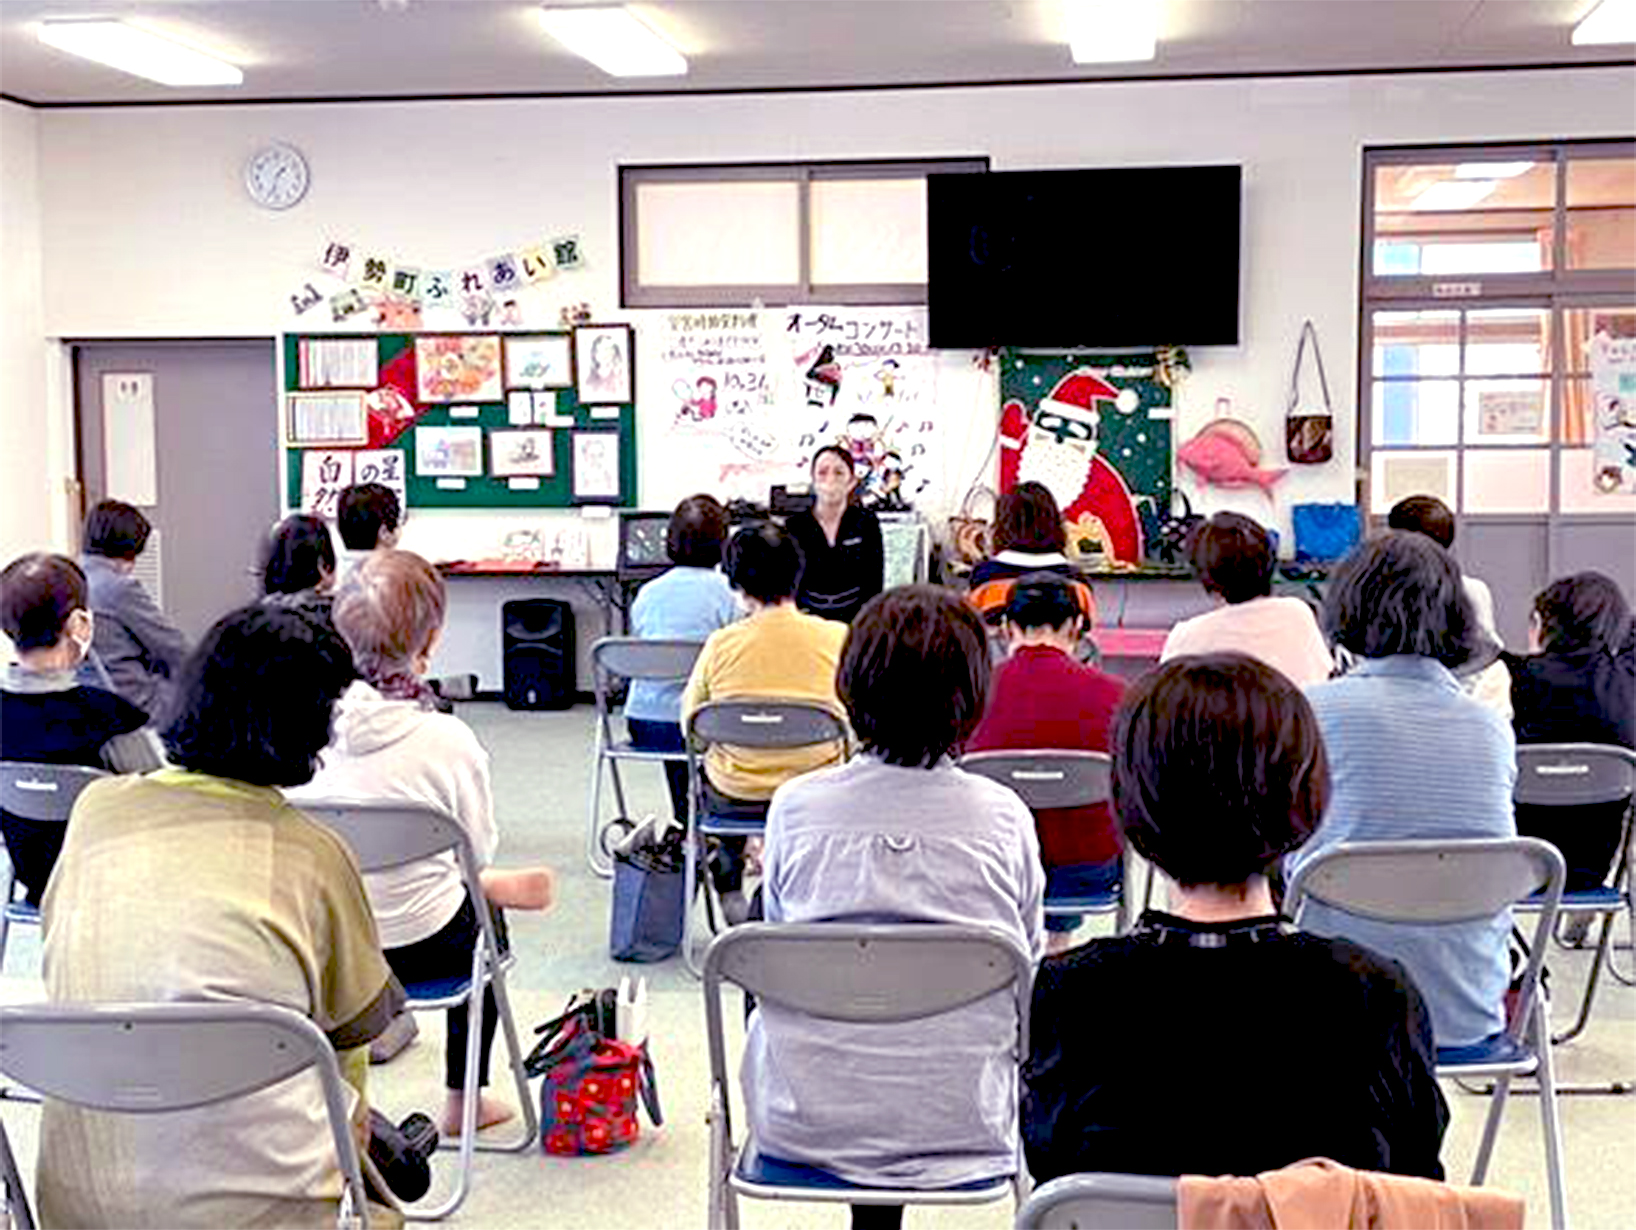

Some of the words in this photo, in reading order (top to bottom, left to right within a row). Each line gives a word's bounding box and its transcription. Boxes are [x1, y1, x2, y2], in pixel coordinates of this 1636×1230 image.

[323, 239, 580, 299] 伊勢町ふれあい館
[786, 313, 918, 341] オータムコンサート
